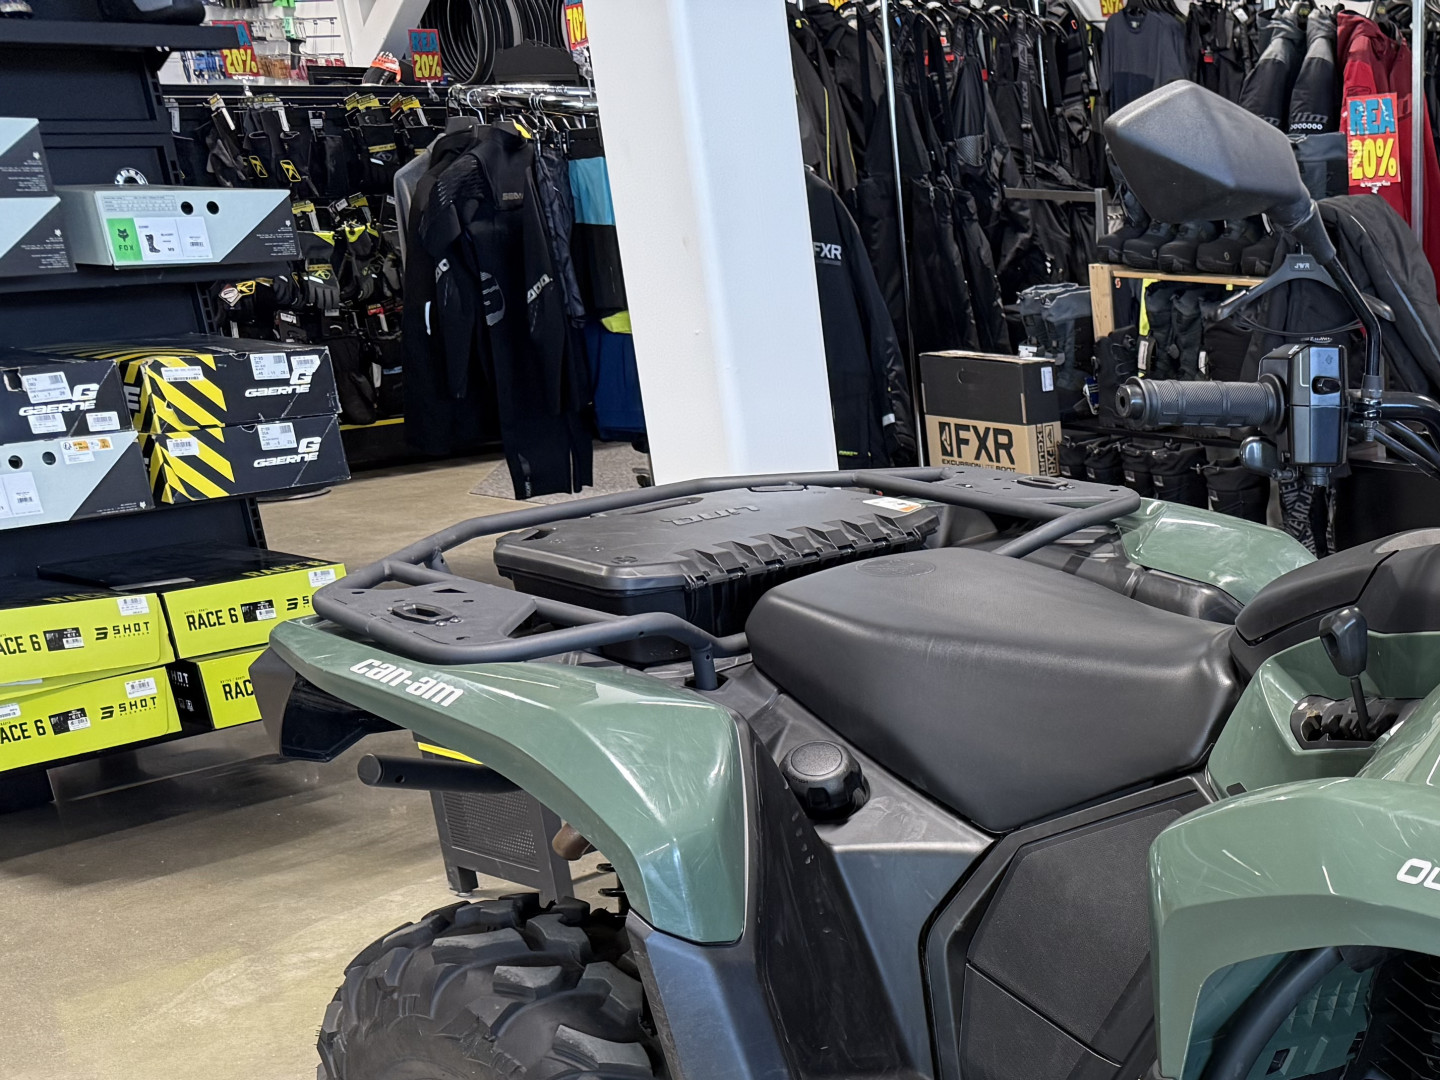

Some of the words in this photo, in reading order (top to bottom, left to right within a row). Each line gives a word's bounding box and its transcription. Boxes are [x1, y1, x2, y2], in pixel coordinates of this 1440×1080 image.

[411, 32, 438, 52] REA
[223, 48, 258, 75] 20%
[414, 55, 442, 78] 20%
[1349, 98, 1395, 136] REA
[1351, 138, 1397, 180] 20%
[812, 241, 842, 260] FXR
[954, 423, 1016, 466] FXR
[112, 621, 149, 635] SHOT
[186, 609, 226, 632] RACE
[228, 607, 239, 623] 6
[0, 636, 27, 655] ACE
[29, 634, 41, 651] 6
[171, 672, 189, 684] HOT
[349, 658, 464, 707] can-am
[222, 679, 254, 701] RAC
[118, 696, 157, 713] SHOT
[0, 721, 31, 745] ACE
[34, 719, 46, 737] 6
